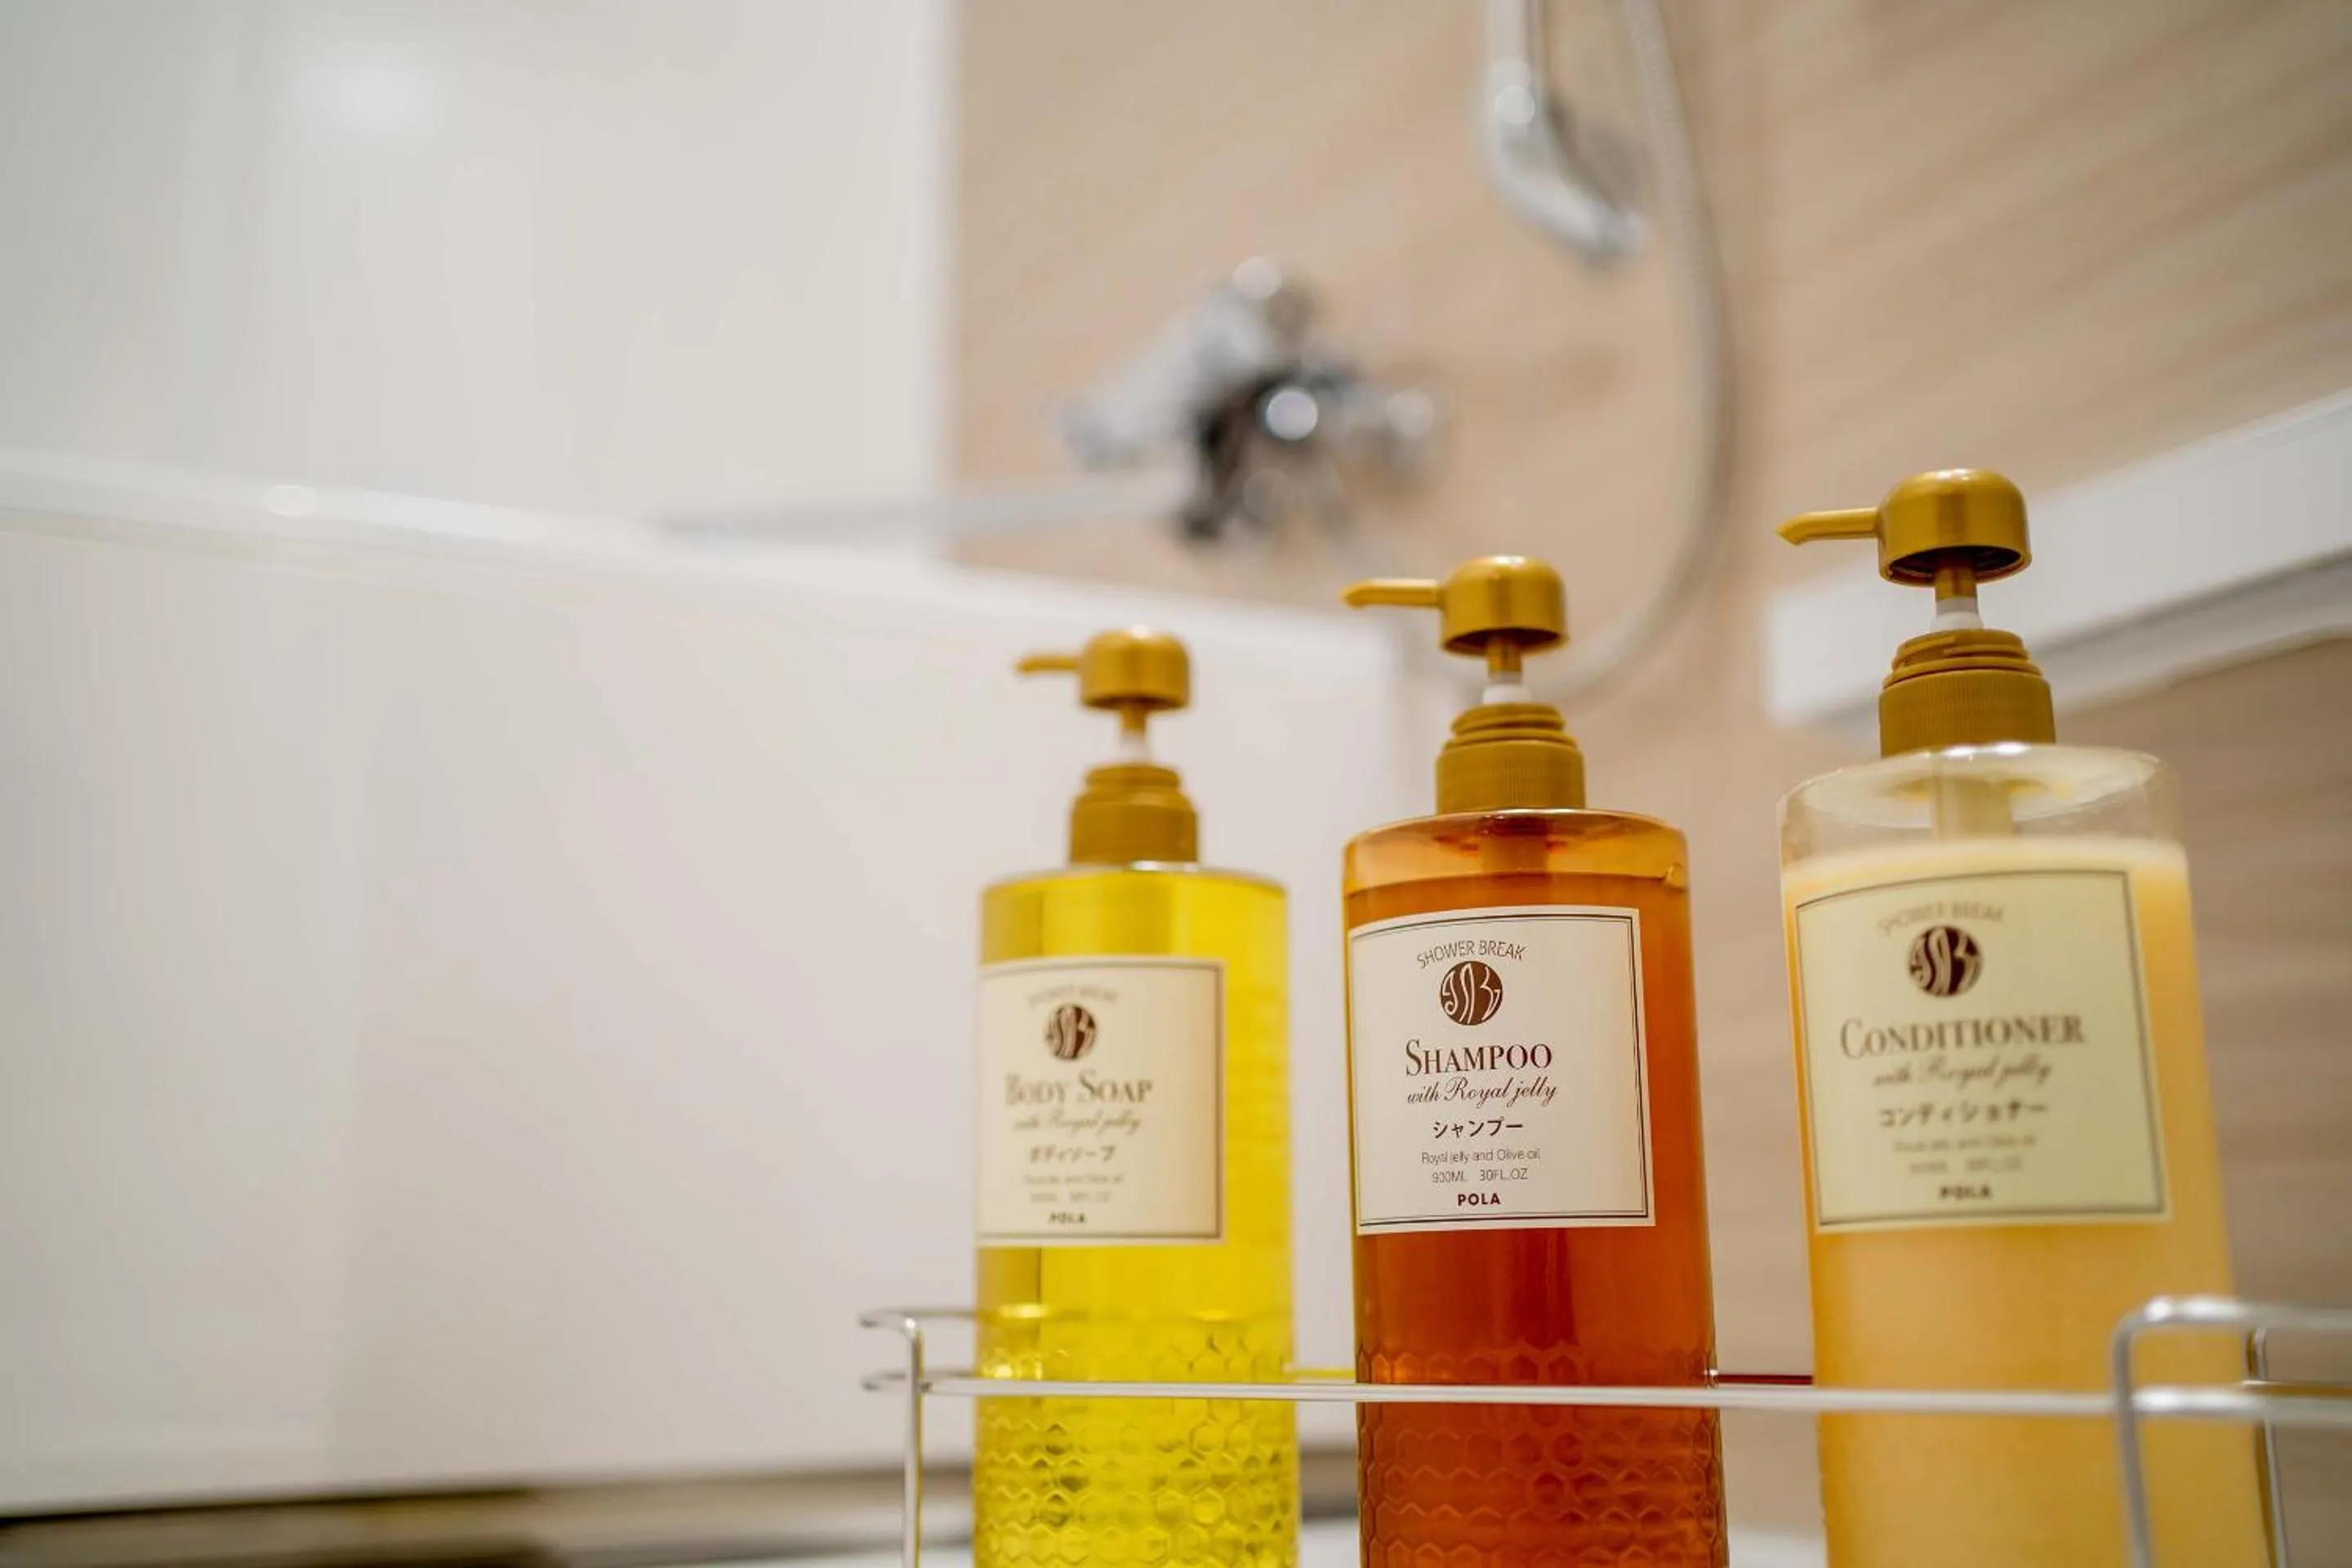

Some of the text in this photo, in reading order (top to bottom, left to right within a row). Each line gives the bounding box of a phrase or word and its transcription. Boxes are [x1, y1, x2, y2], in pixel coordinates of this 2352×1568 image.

[1417, 941, 1528, 969] SHOWER BREAK
[1840, 1017, 2085, 1060] CONDITIONER
[1405, 1039, 1552, 1076] SHAMPOO
[1005, 1068, 1153, 1107] BODY SOAP
[1407, 1076, 1557, 1109] with Royal jelly
[1433, 1116, 1523, 1139] シャンプー
[1421, 1151, 1448, 1165] Royal
[1472, 1149, 1494, 1161] and
[1496, 1147, 1525, 1161] Olive
[1526, 1147, 1541, 1160] oil
[1457, 1192, 1501, 1206] POLA
